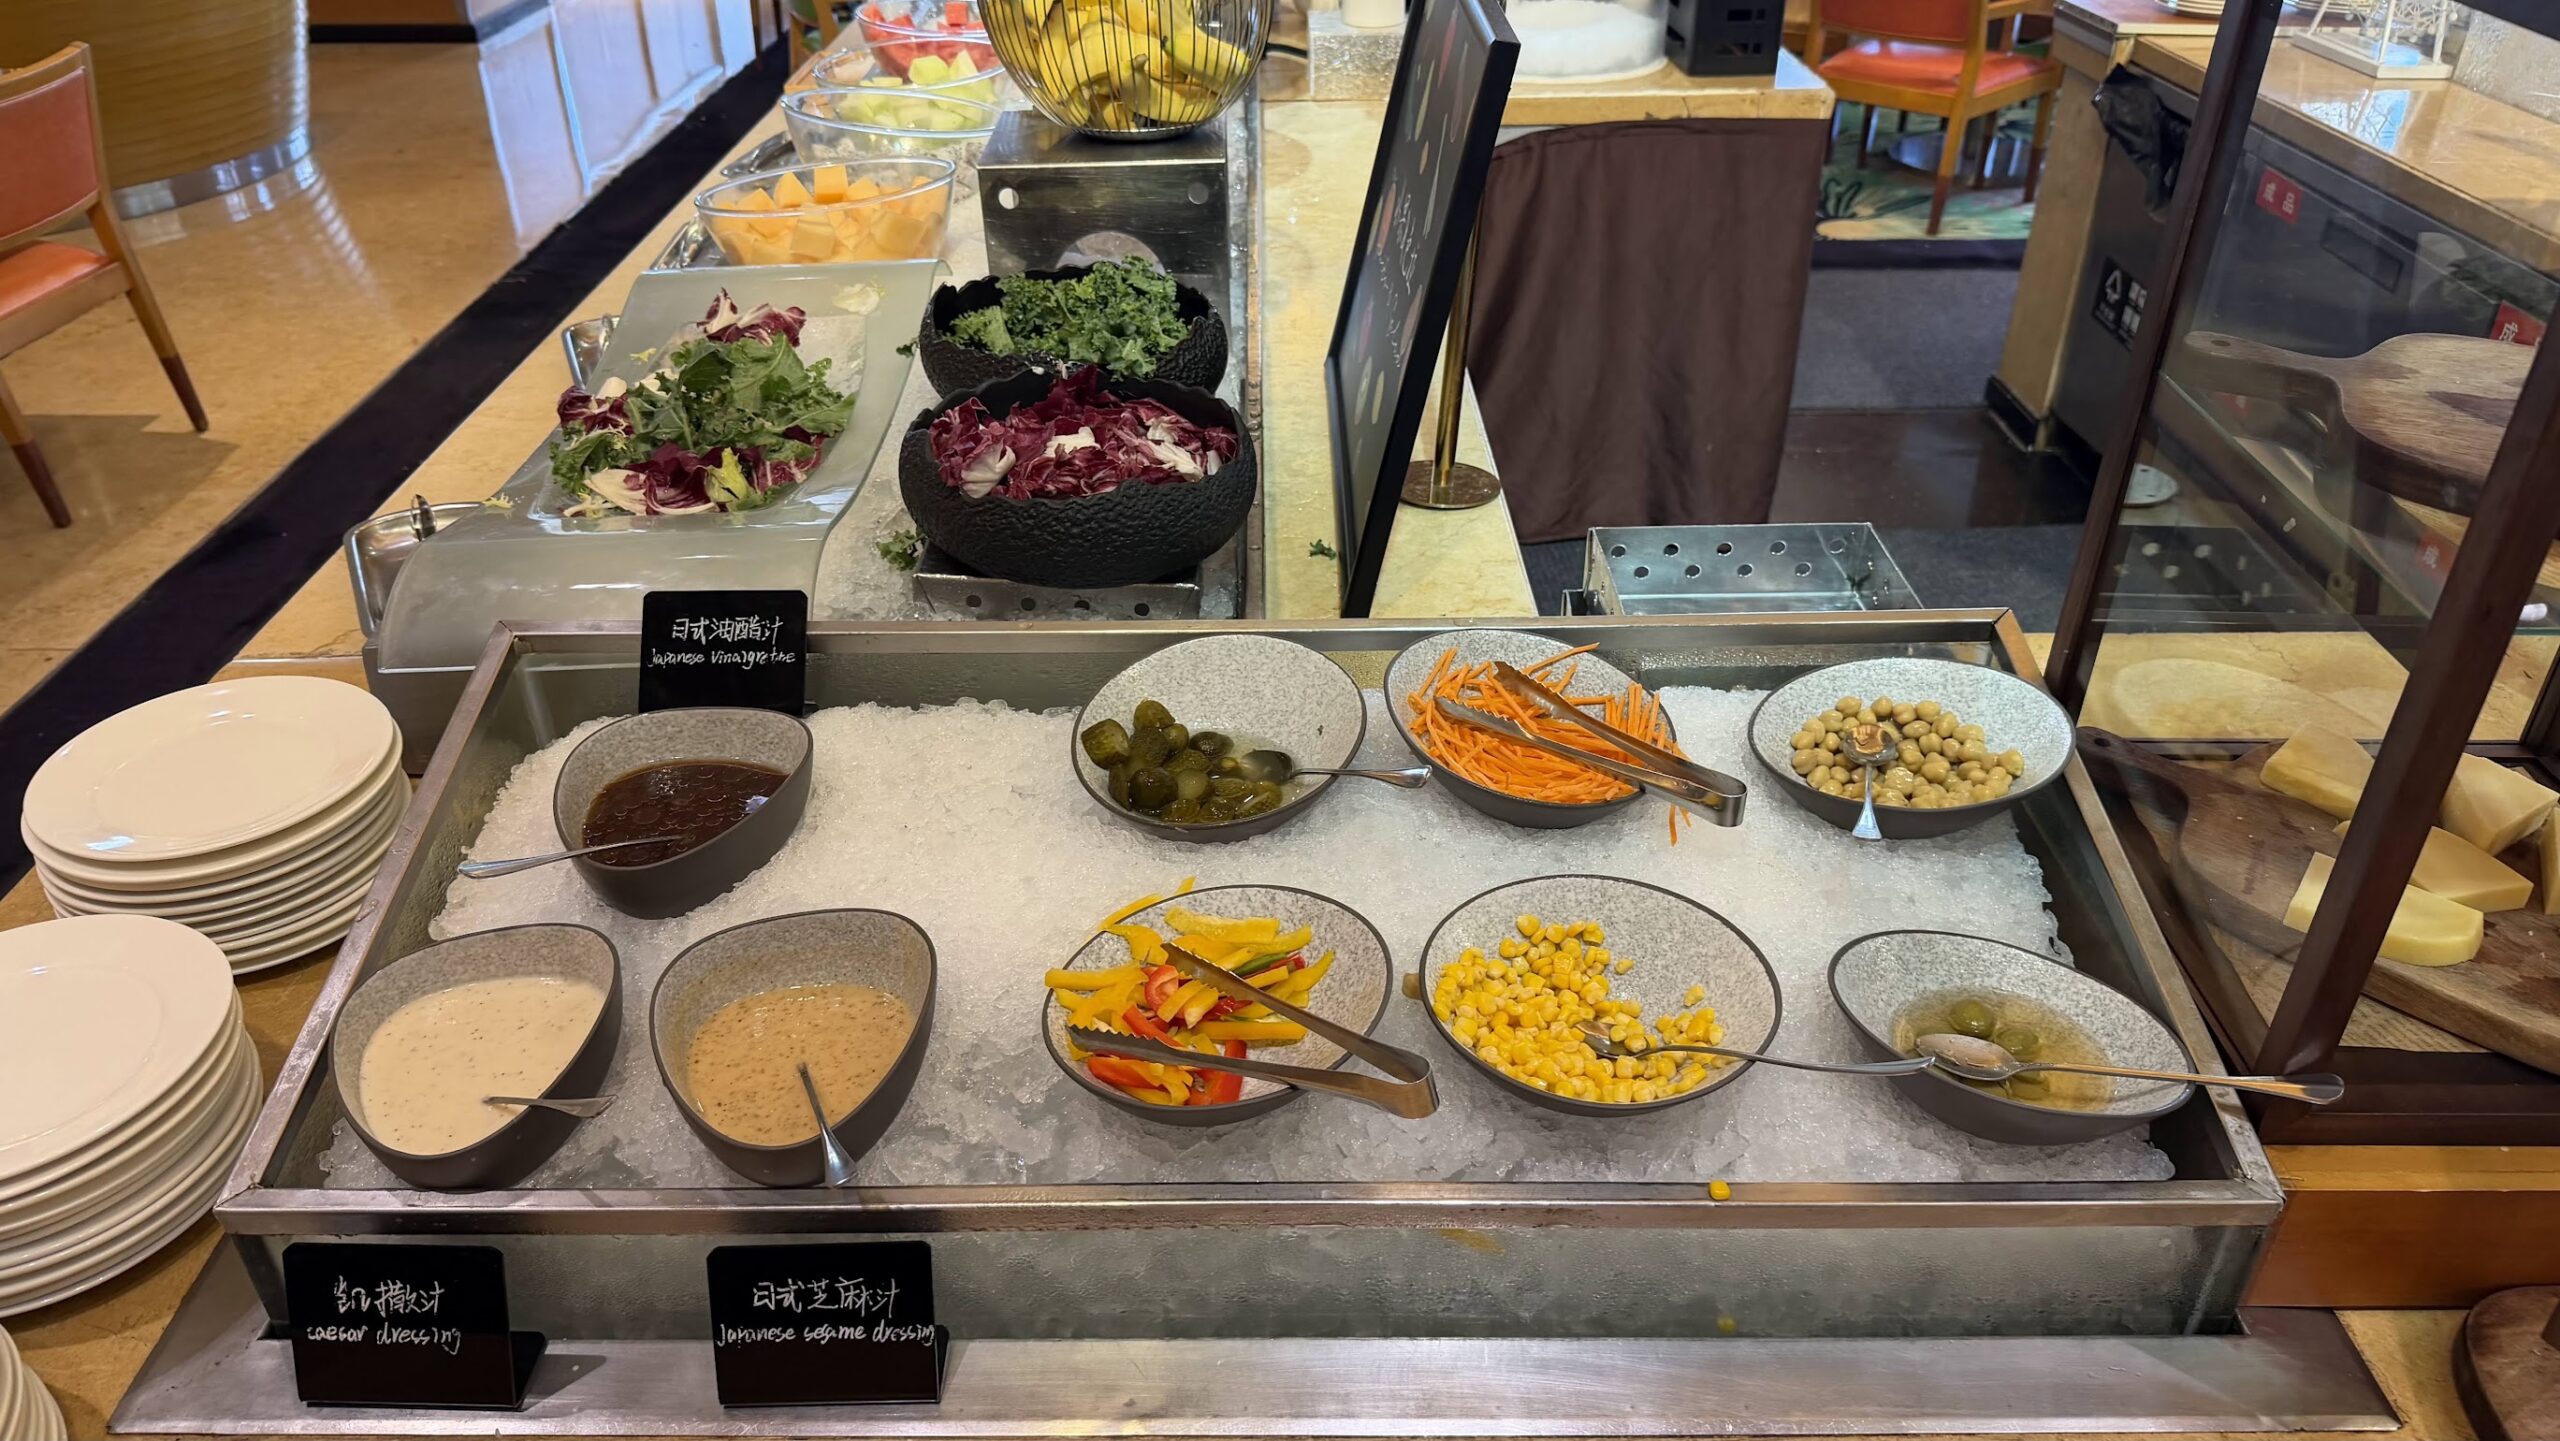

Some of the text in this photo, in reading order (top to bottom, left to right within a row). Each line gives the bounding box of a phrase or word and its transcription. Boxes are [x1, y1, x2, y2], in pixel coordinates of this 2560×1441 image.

[672, 614, 784, 646] 日式油醋汁
[334, 1275, 445, 1318] 凯撒汁
[752, 1276, 900, 1318] 日式芝麻汁
[306, 1321, 461, 1355] caesar dressing
[872, 1318, 936, 1347] dressing
